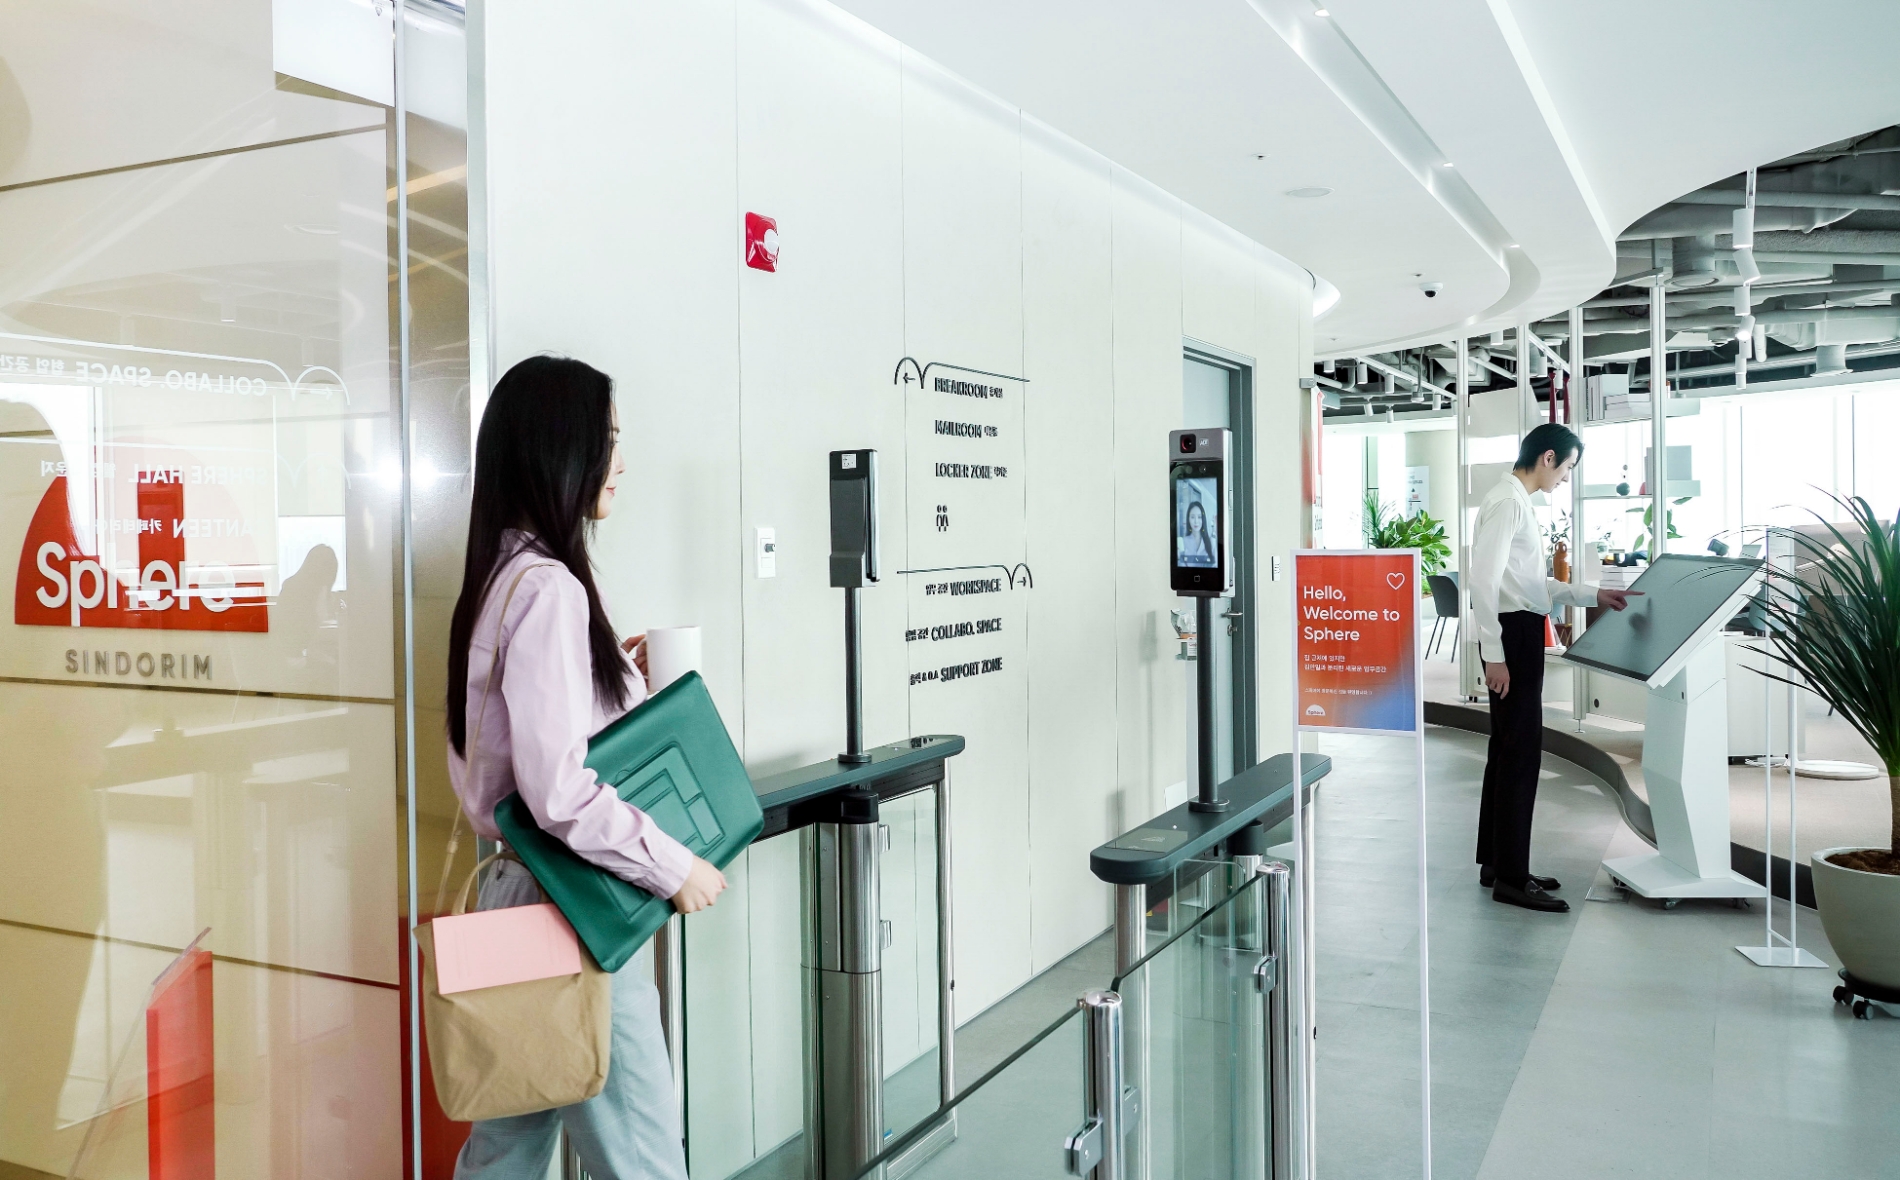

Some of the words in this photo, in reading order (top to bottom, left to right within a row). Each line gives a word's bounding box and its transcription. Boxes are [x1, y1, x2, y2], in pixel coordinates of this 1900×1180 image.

[934, 377, 988, 399] BREAKROOM
[934, 419, 982, 439] MAILROOM
[935, 462, 969, 479] LOCKER
[970, 464, 993, 480] ZONE
[36, 541, 236, 628] Sphere
[950, 578, 1002, 596] WORKSPACE
[1303, 585, 1346, 602] Hello,
[1303, 605, 1378, 621] Welcome
[1382, 608, 1400, 622] to
[931, 621, 975, 641] COLLABO.
[976, 617, 1002, 634] SPACE
[1303, 626, 1360, 644] Sphere
[65, 649, 213, 681] SINDORIM
[940, 661, 980, 682] SUPPORT
[981, 656, 1002, 673] ZONE
